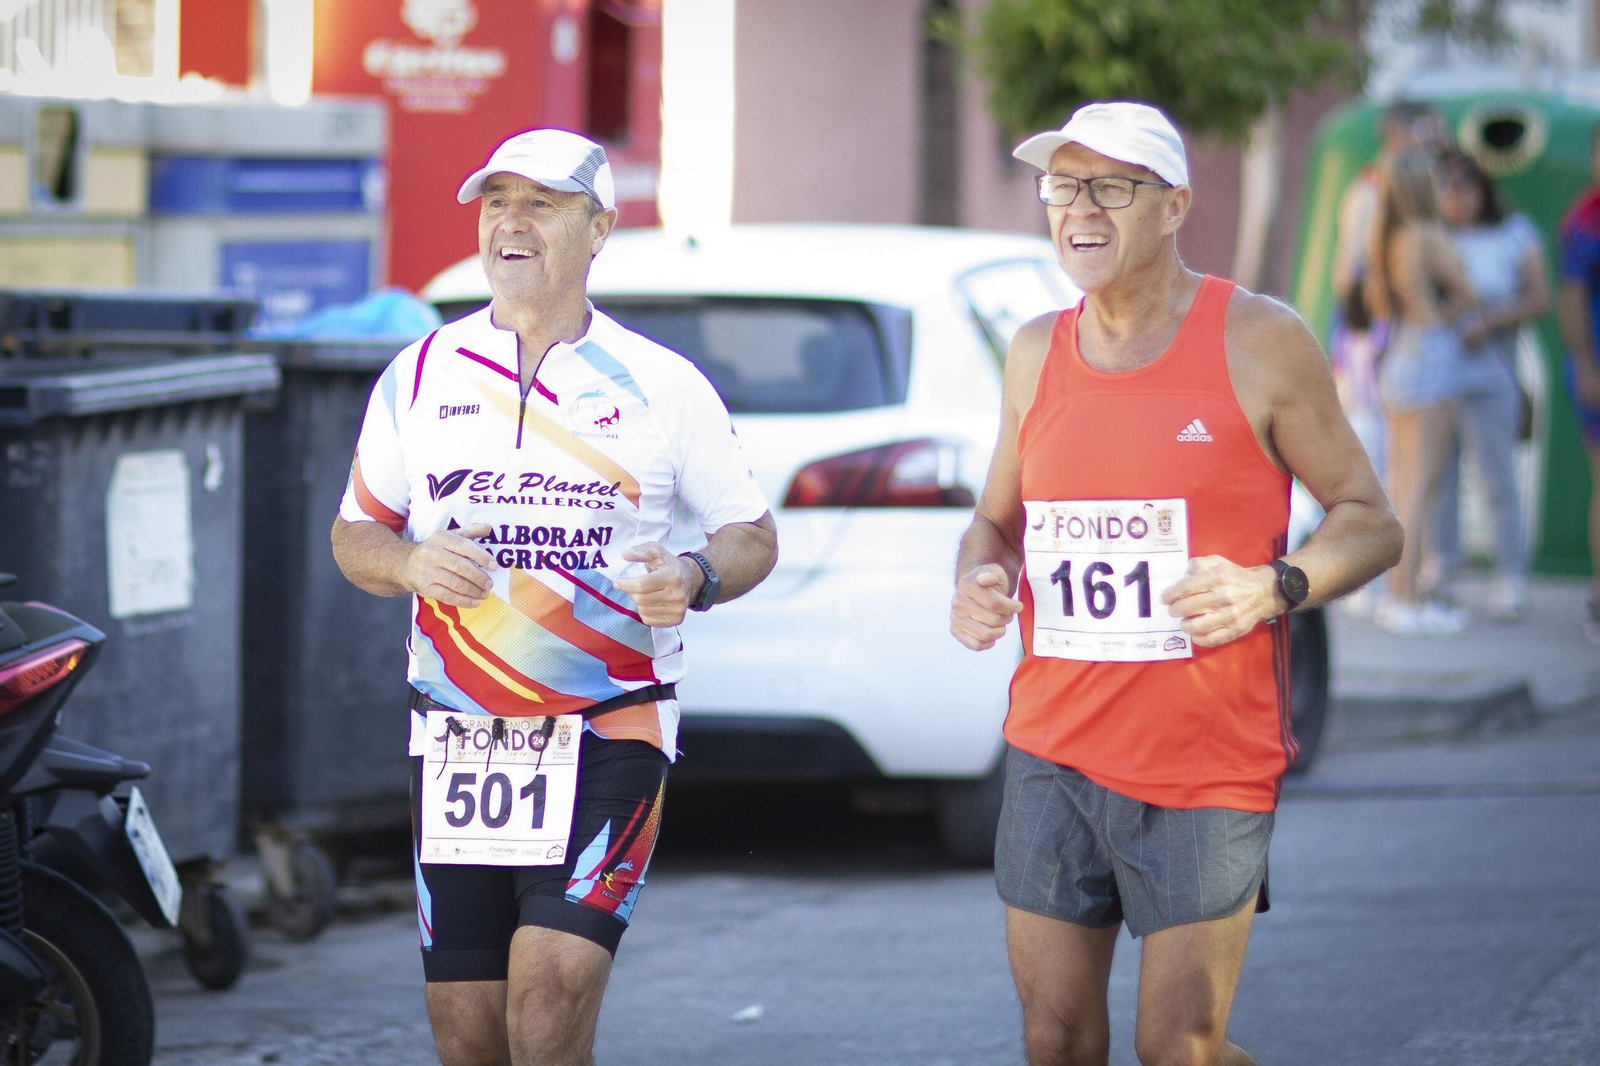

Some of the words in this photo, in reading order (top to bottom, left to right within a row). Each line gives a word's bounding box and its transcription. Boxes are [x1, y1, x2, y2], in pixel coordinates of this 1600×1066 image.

[1176, 433, 1213, 442] adidas
[469, 471, 505, 492] El
[518, 472, 621, 497] Plantel
[468, 494, 615, 511] SEMILLEROS
[479, 524, 614, 548] ALBORANI
[1055, 515, 1148, 539] FONDO
[1050, 560, 1152, 620] 161
[461, 719, 491, 729] GRAN
[445, 772, 547, 829] 501
